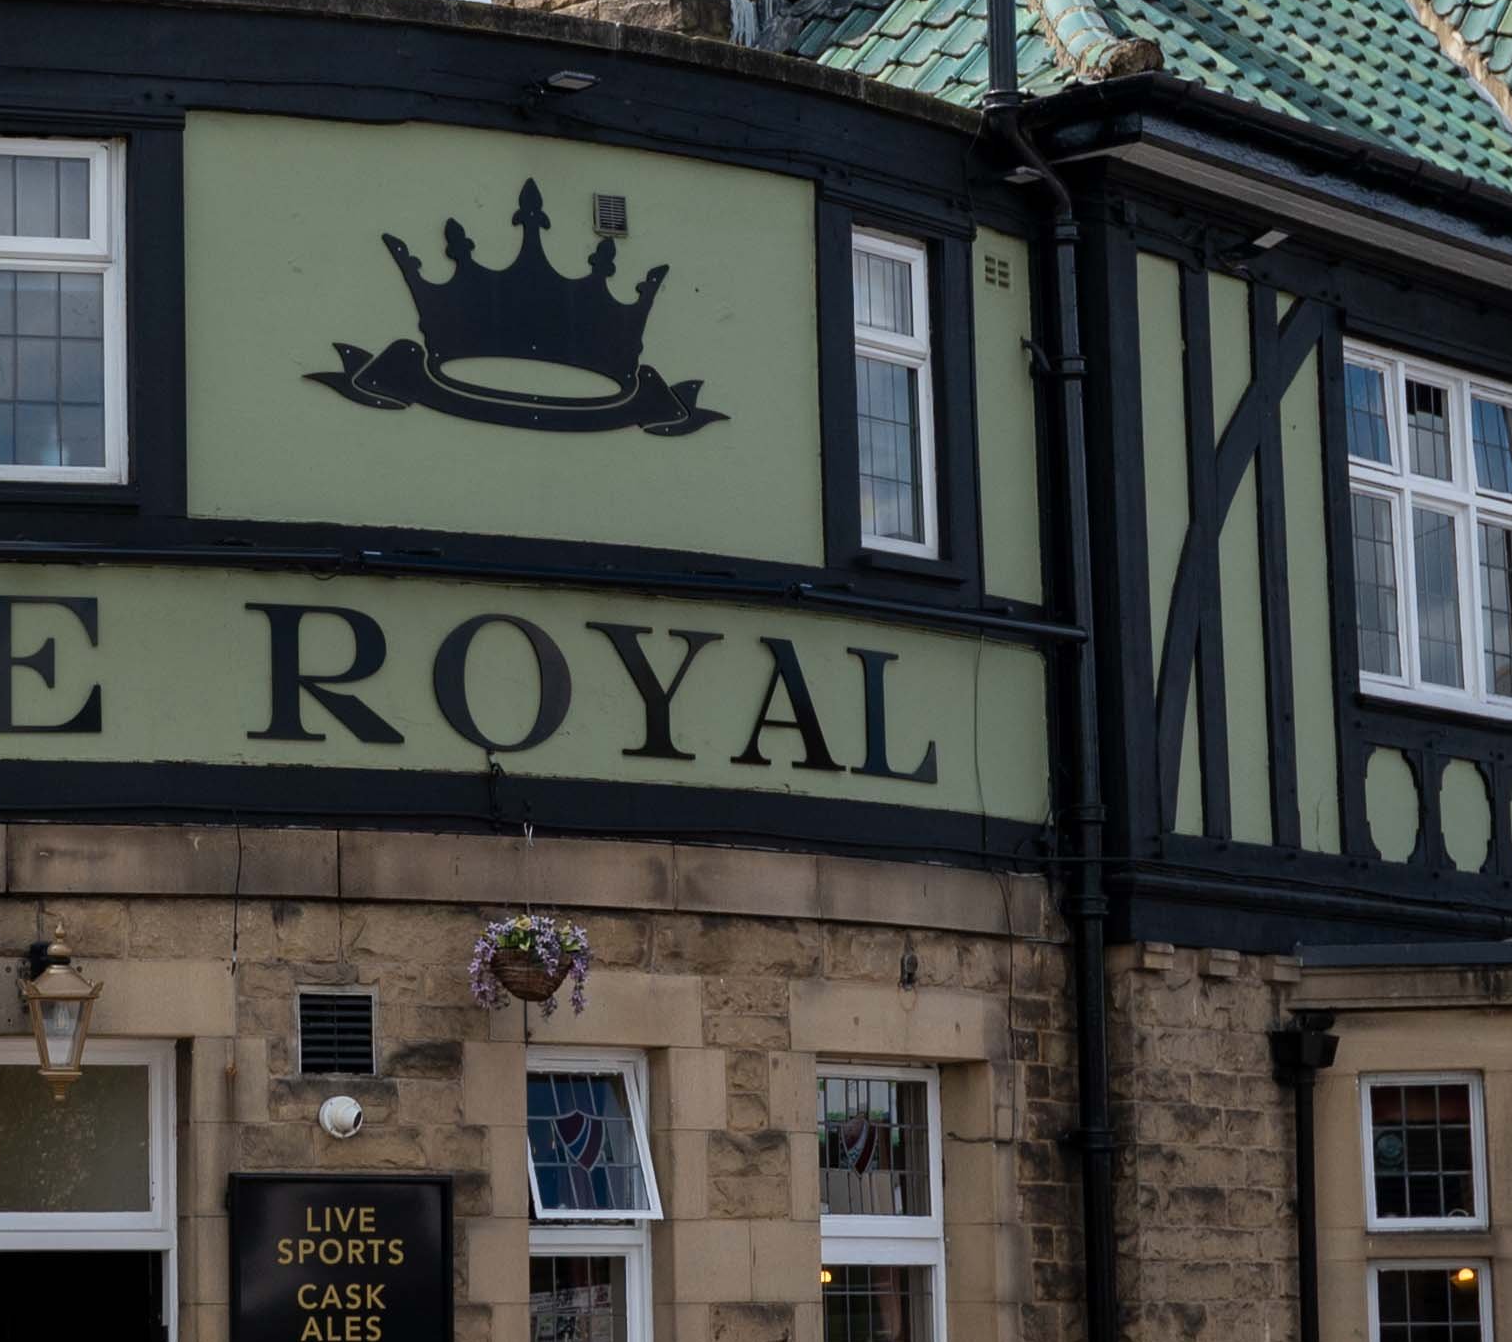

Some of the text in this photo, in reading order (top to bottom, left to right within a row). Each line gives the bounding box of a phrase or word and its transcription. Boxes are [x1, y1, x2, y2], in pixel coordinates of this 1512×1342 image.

[244, 602, 939, 787] ROYAL
[306, 1206, 376, 1233] LIVE
[277, 1238, 405, 1265] SPORTS
[297, 1283, 386, 1310] CASK
[300, 1316, 382, 1342] ALES
